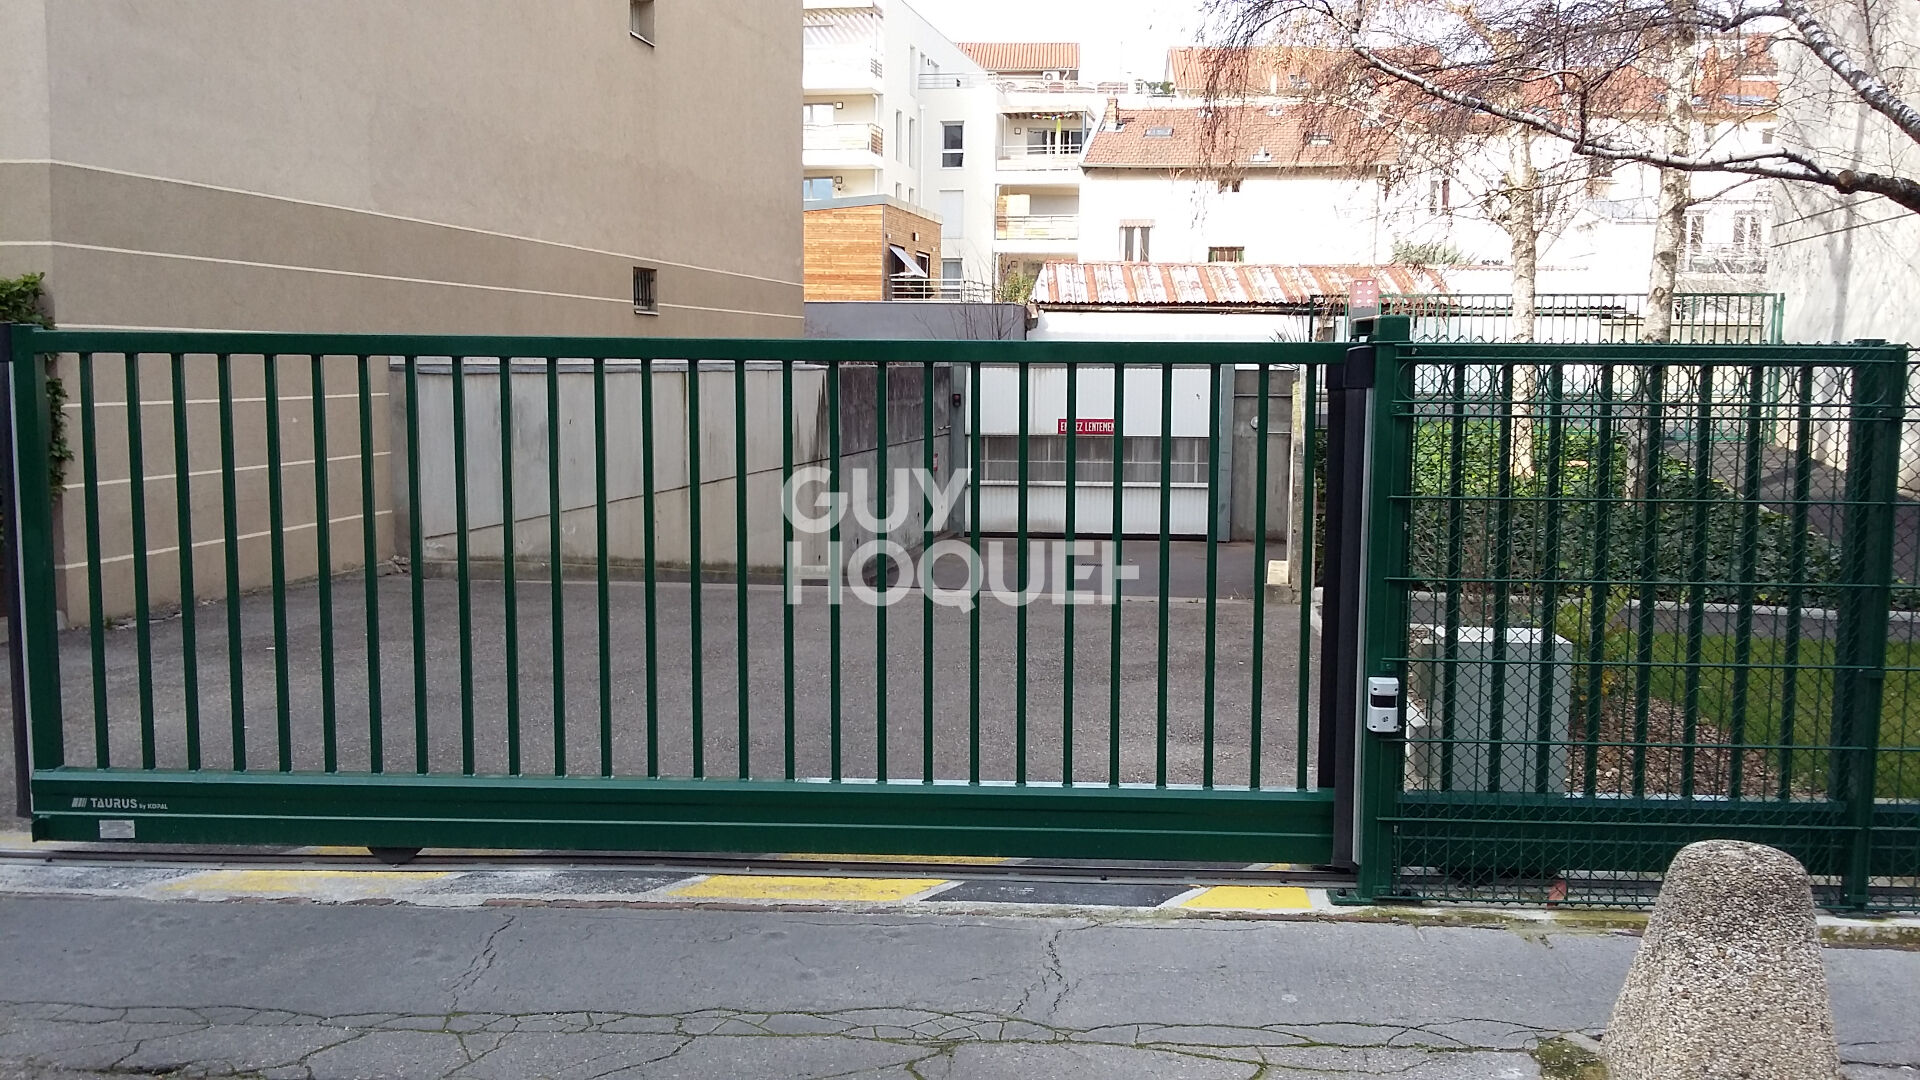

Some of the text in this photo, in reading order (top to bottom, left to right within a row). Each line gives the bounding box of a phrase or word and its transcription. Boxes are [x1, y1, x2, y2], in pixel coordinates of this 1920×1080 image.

[1060, 422, 1115, 432] EEZ LENTEMEN
[90, 798, 137, 809] TAURUS
